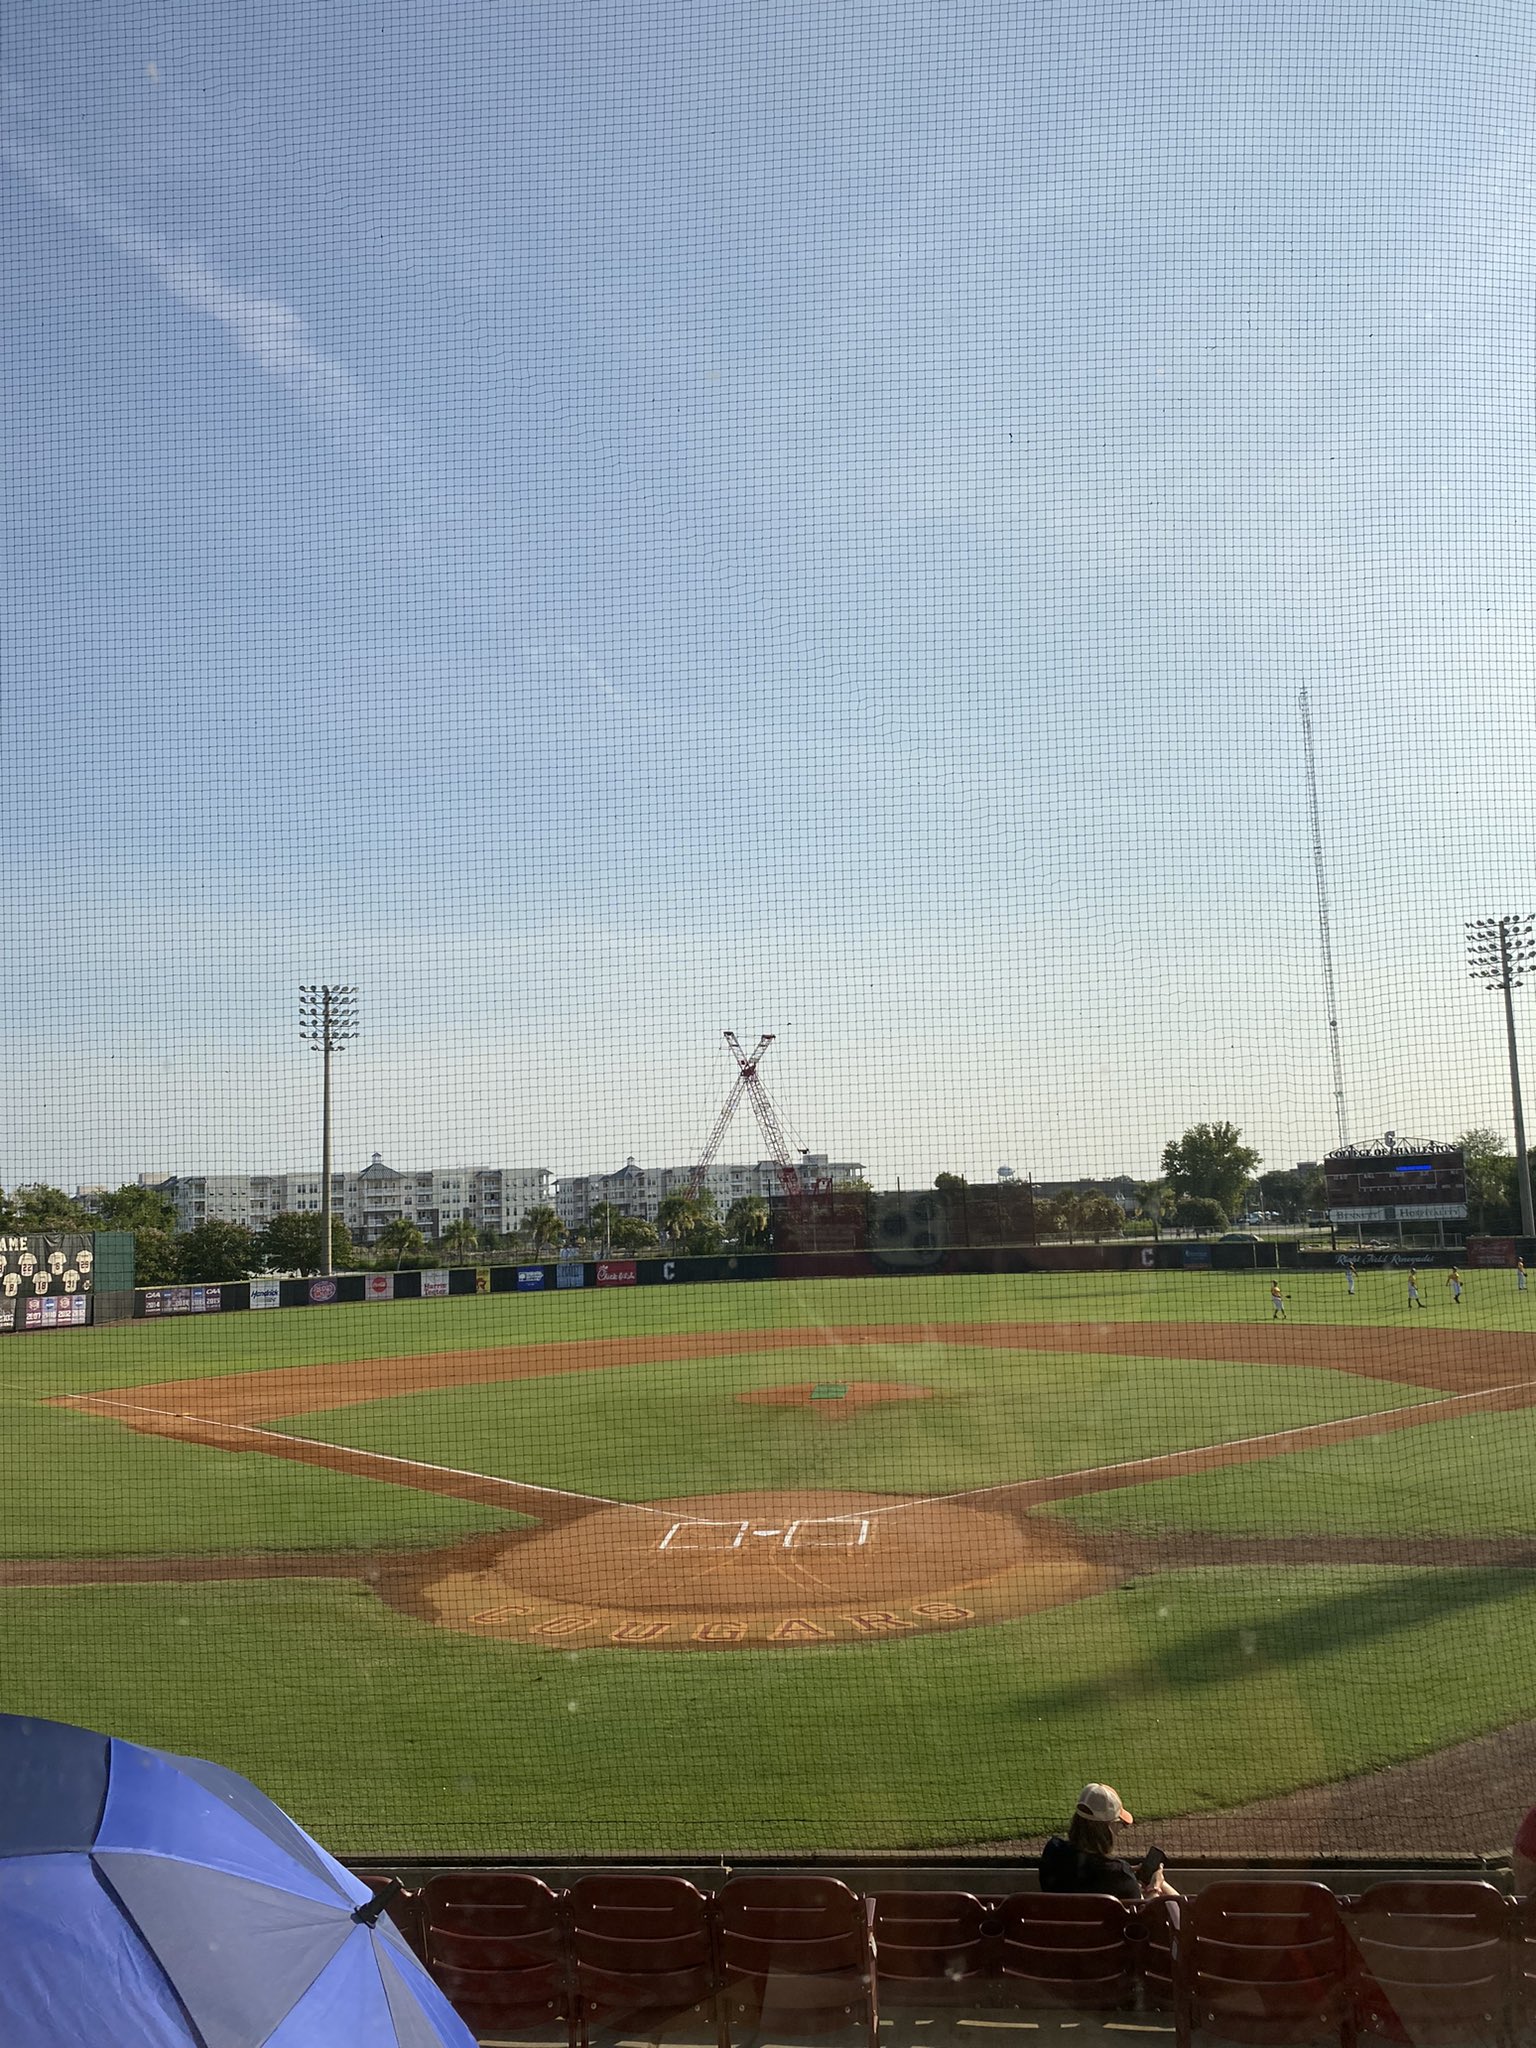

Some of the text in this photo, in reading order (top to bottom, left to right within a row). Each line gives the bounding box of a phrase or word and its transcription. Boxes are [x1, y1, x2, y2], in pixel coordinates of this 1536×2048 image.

[1374, 1148, 1388, 1157] OF
[1141, 1248, 1154, 1266] C
[663, 1261, 675, 1281] C
[251, 1289, 279, 1299] Hendrick
[468, 1601, 977, 1644] COUGARS
